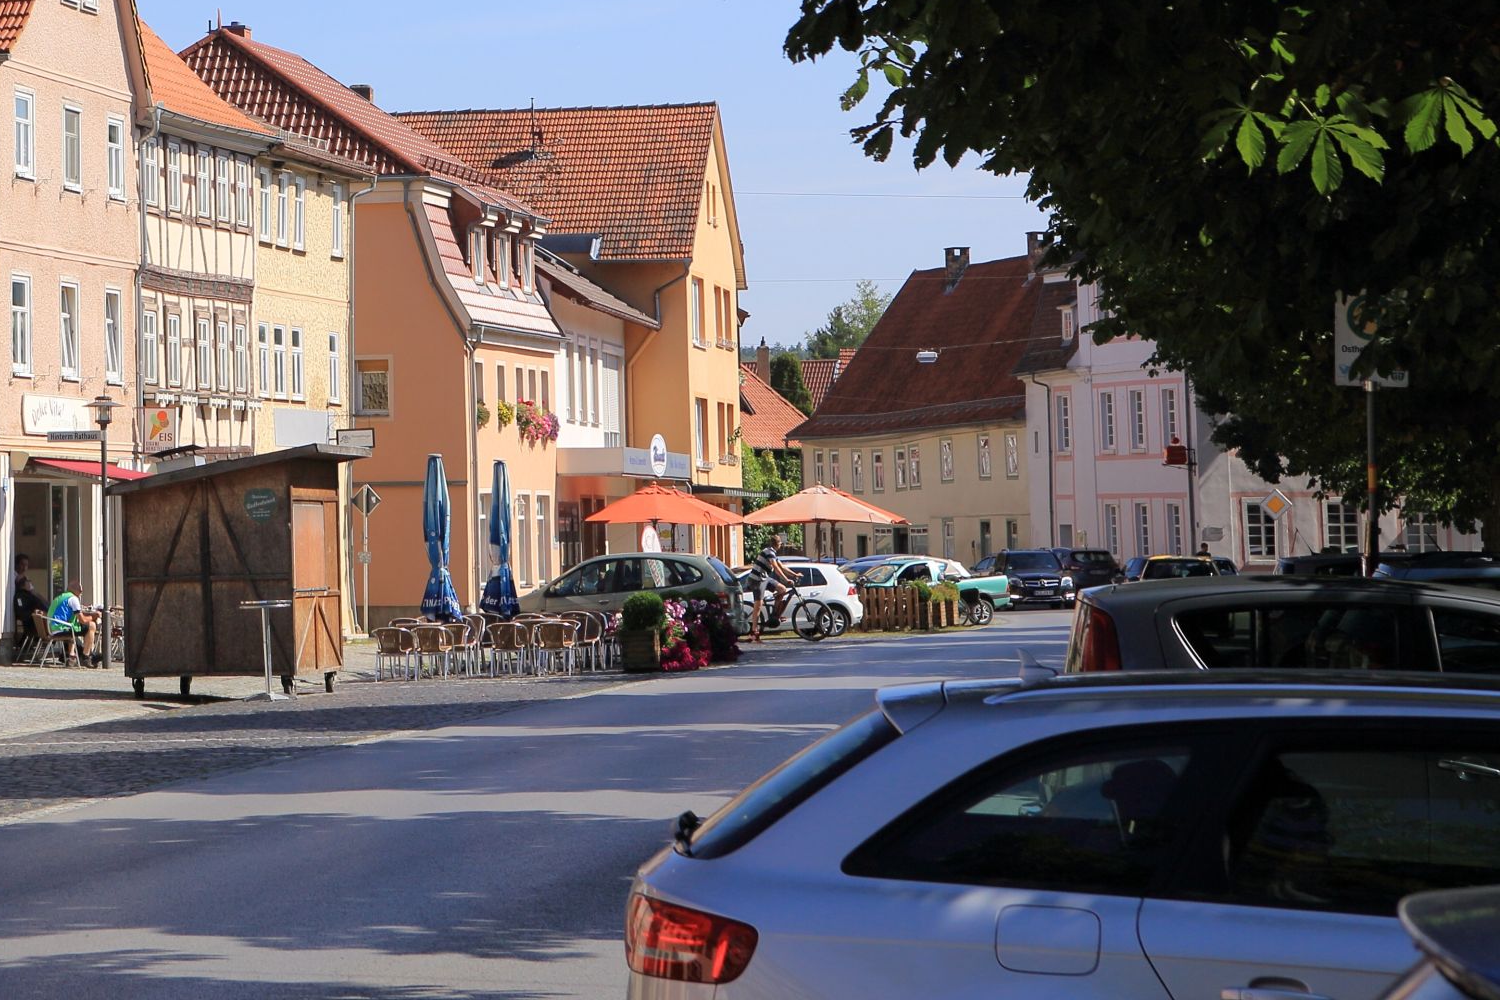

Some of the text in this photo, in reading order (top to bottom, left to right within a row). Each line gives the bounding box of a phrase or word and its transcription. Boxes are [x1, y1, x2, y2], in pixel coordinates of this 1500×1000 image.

[50, 432, 98, 440] Hinterm Rathaus
[159, 432, 173, 441] EIS
